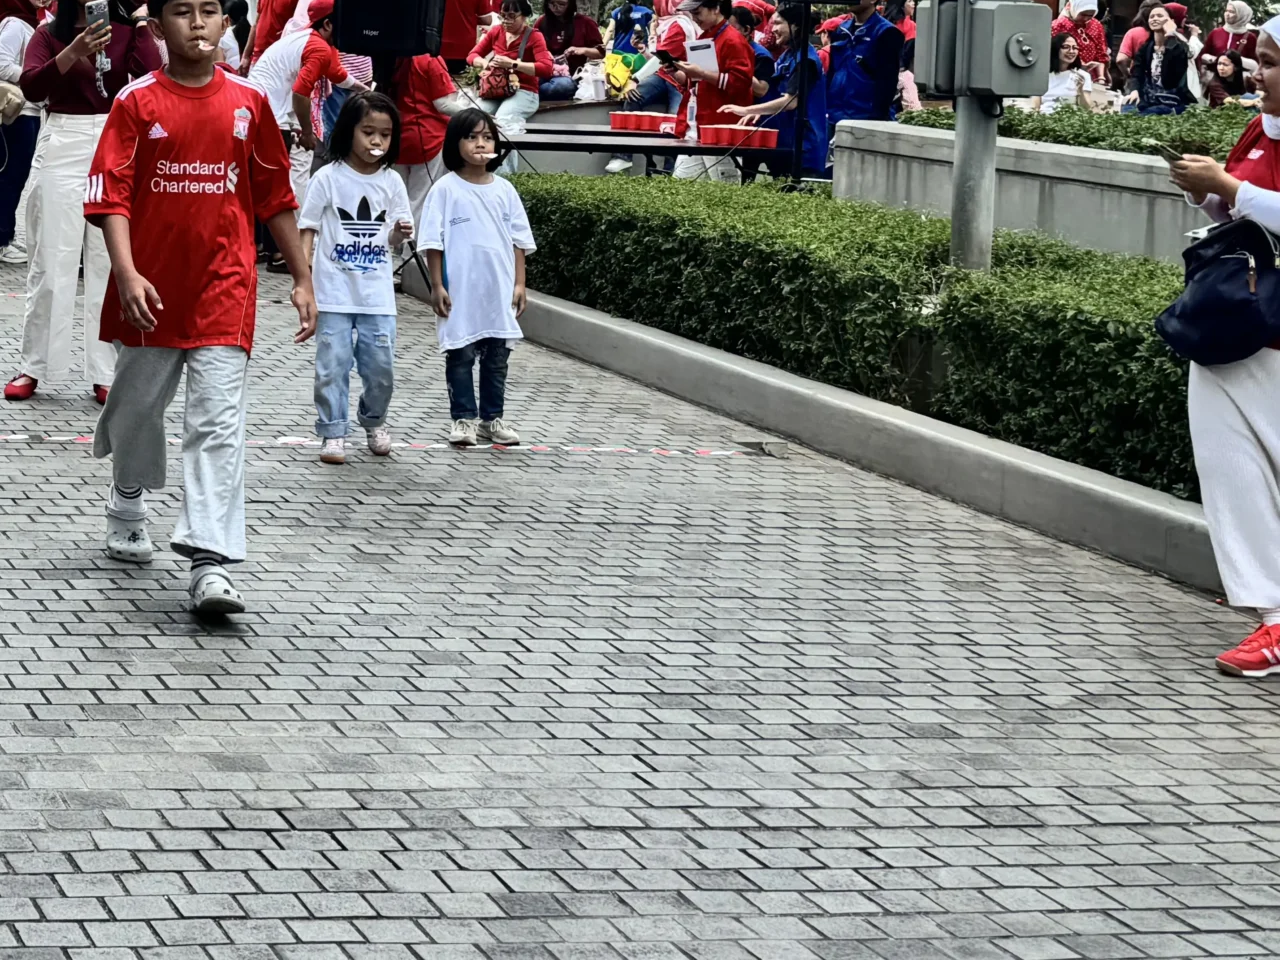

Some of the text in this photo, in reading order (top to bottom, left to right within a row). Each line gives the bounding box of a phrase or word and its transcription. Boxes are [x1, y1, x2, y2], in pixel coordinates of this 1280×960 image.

[156, 160, 225, 175] Standard
[150, 177, 224, 194] Chartered
[335, 241, 385, 257] adidas
